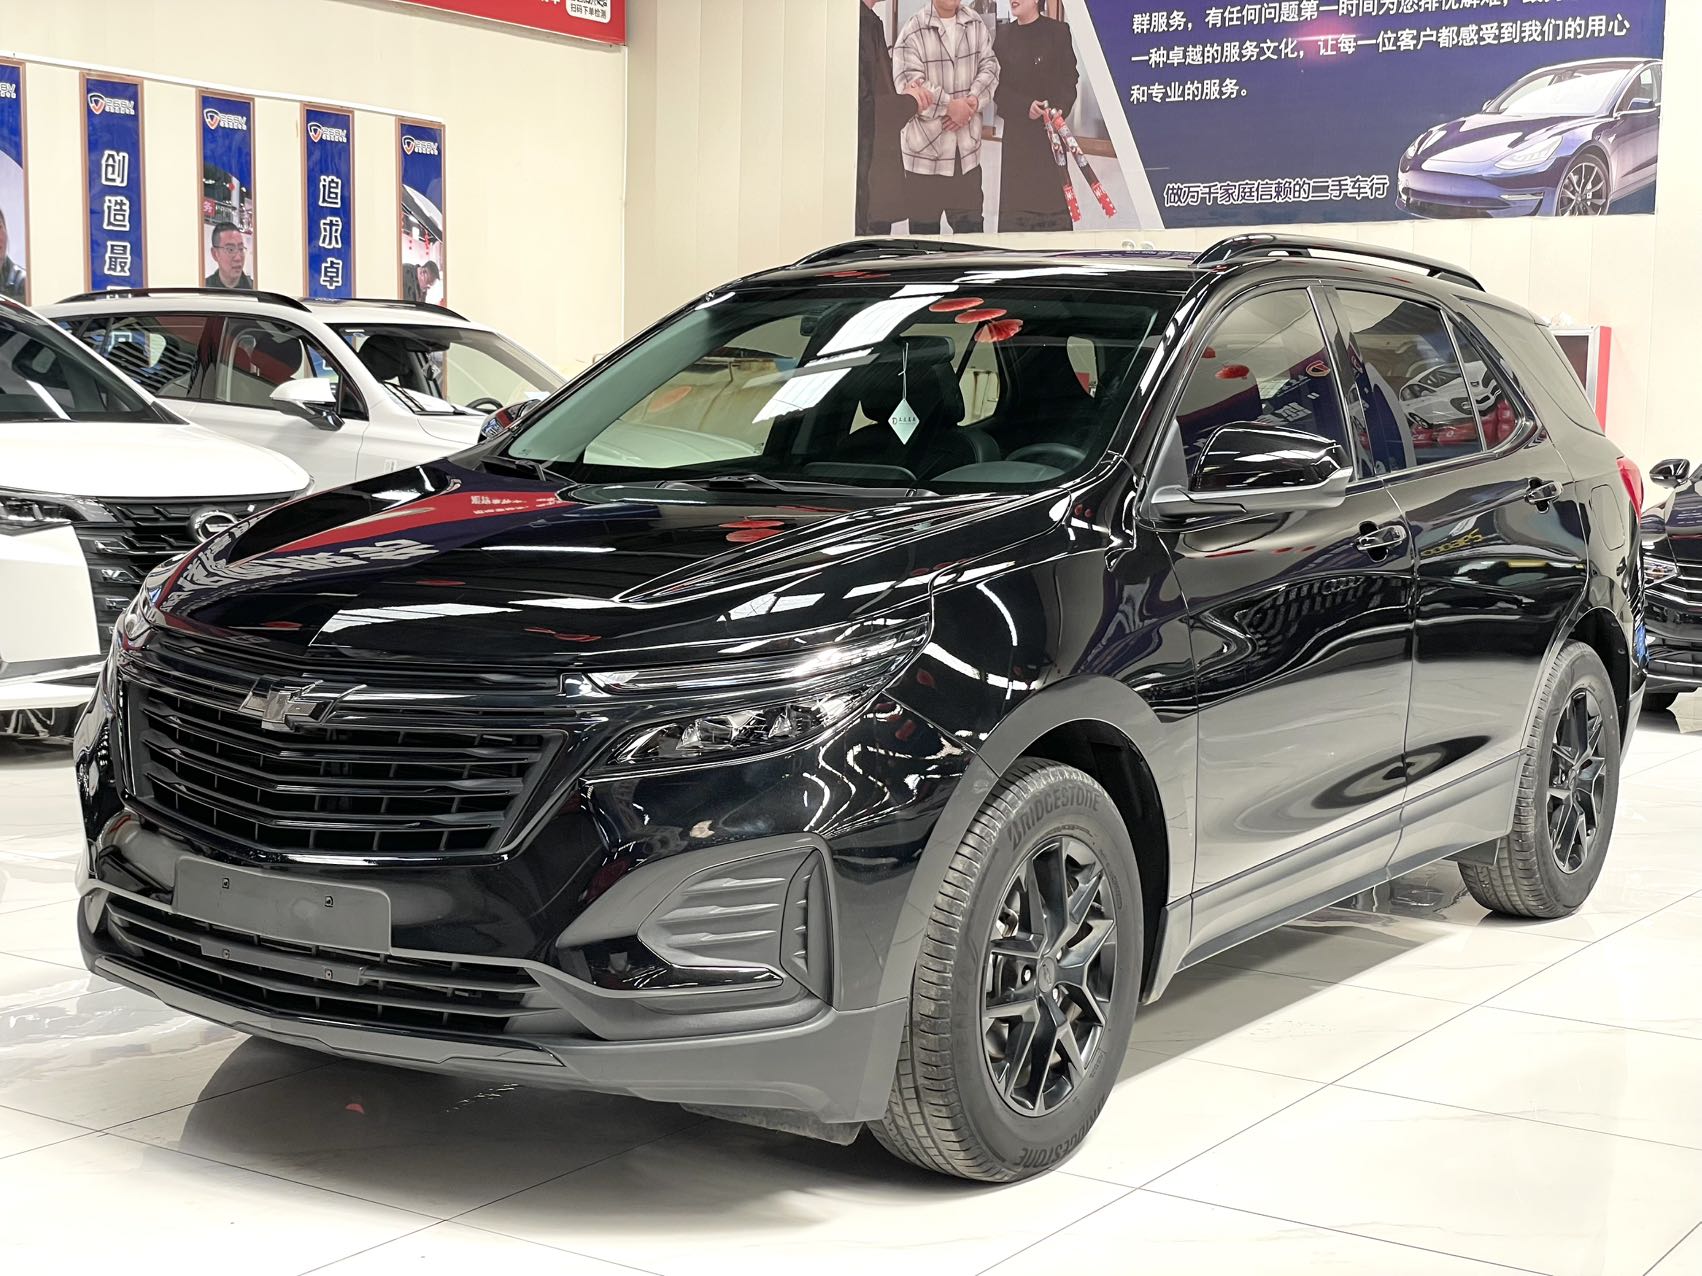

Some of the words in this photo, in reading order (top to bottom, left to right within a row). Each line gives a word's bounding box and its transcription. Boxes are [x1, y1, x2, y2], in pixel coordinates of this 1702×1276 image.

[570, 4, 606, 19] 扫码下单检测
[1131, 13, 1631, 68] 一种卓越的服务文化，让每一位客户都感受到我们的用心
[1130, 78, 1249, 105] 和专业的服务。
[1164, 174, 1390, 207] 做万千家庭信赖的二手车行
[101, 150, 132, 299] 创造最
[318, 175, 342, 290] 追求卓
[1007, 784, 1100, 851] BRIDGESTONE
